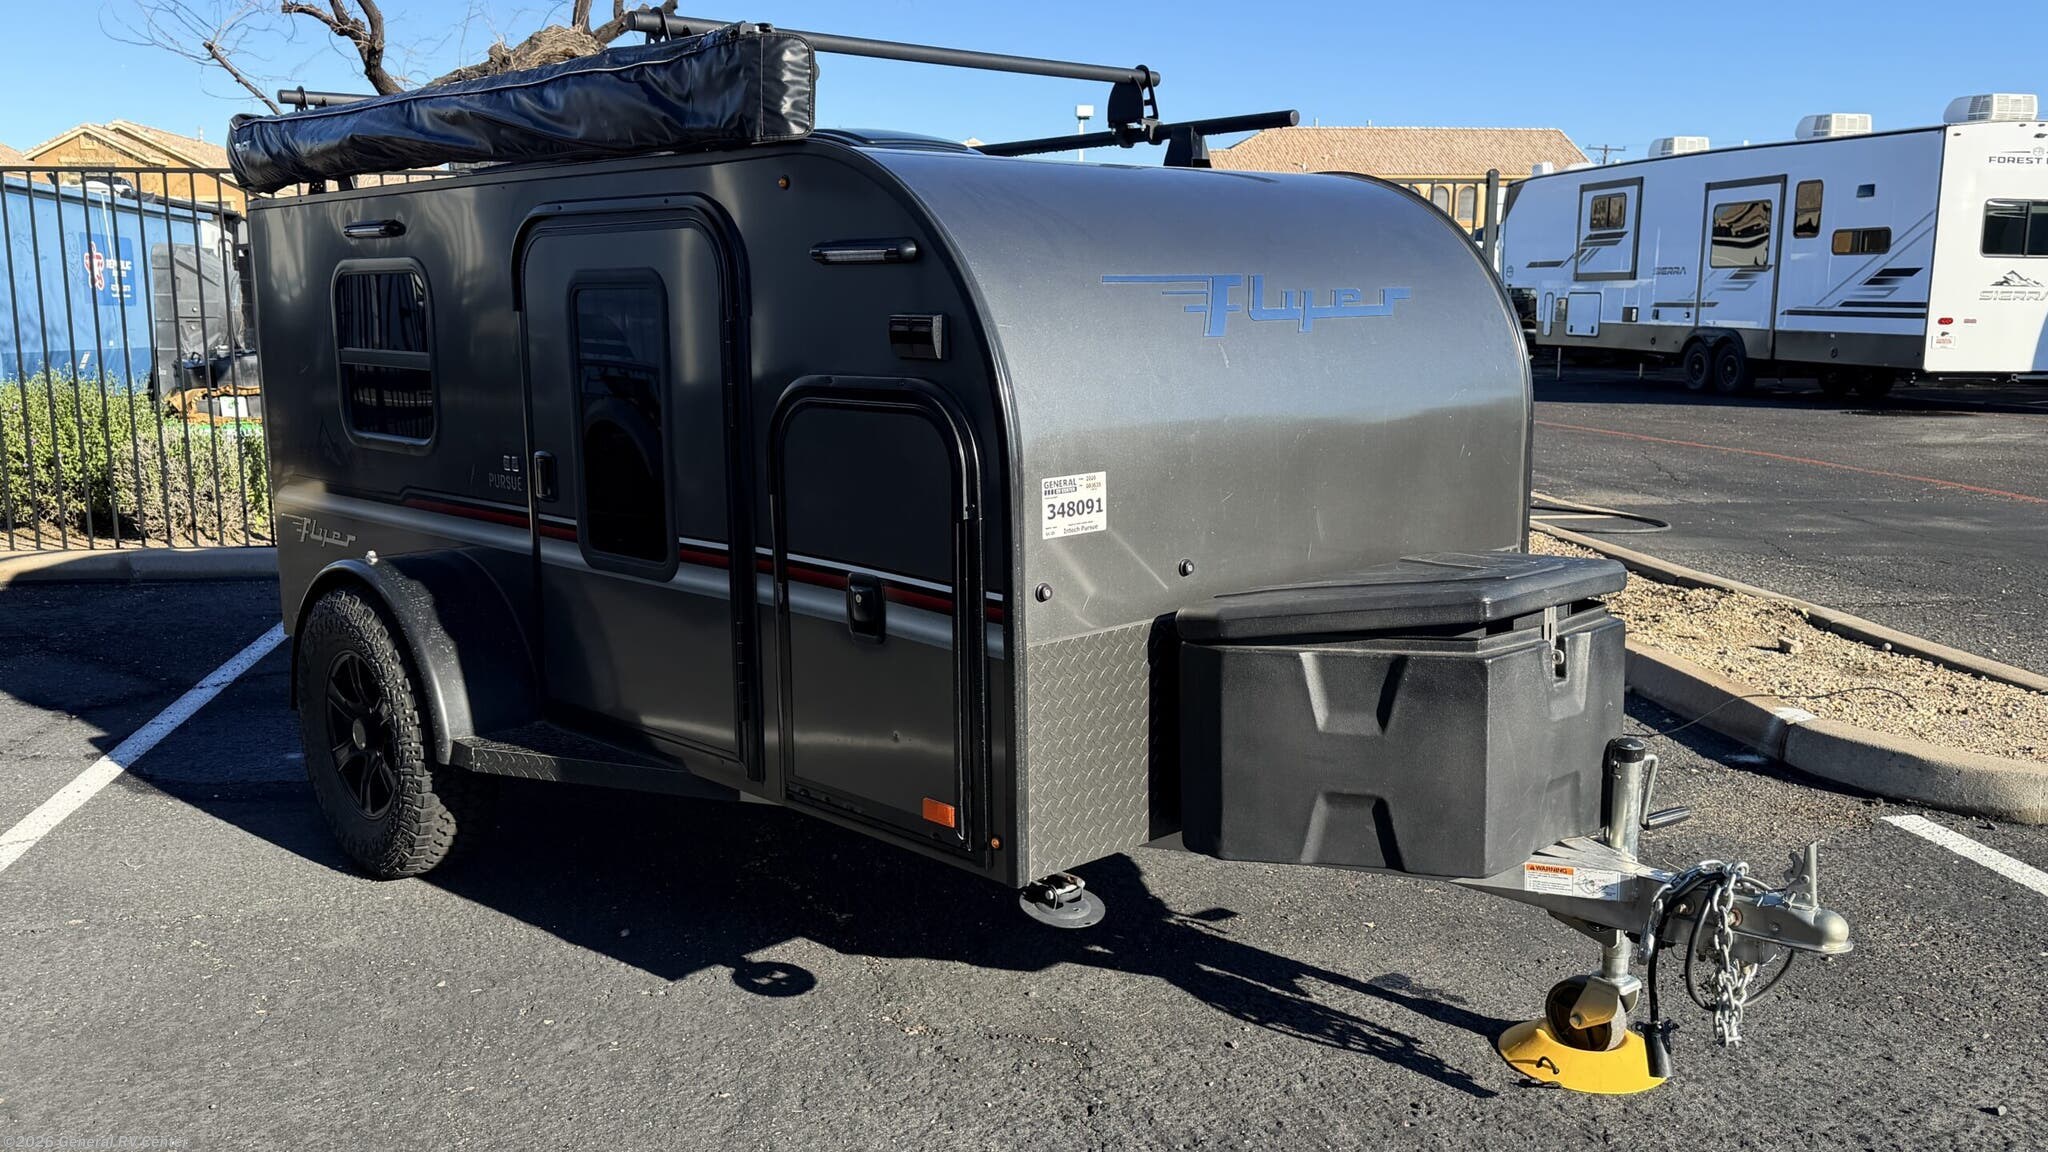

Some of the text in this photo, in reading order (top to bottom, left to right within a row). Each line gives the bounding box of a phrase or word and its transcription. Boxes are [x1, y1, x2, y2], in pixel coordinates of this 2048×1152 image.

[1988, 156, 2043, 164] FOREST
[1653, 266, 1687, 275] SIERRA
[1102, 273, 1412, 337] Flyer
[488, 472, 522, 491] PURSUE
[1044, 478, 1077, 489] GENERAL
[1047, 497, 1103, 520] 348091
[281, 512, 356, 547] Flyer
[1535, 865, 1568, 874] WARNING
